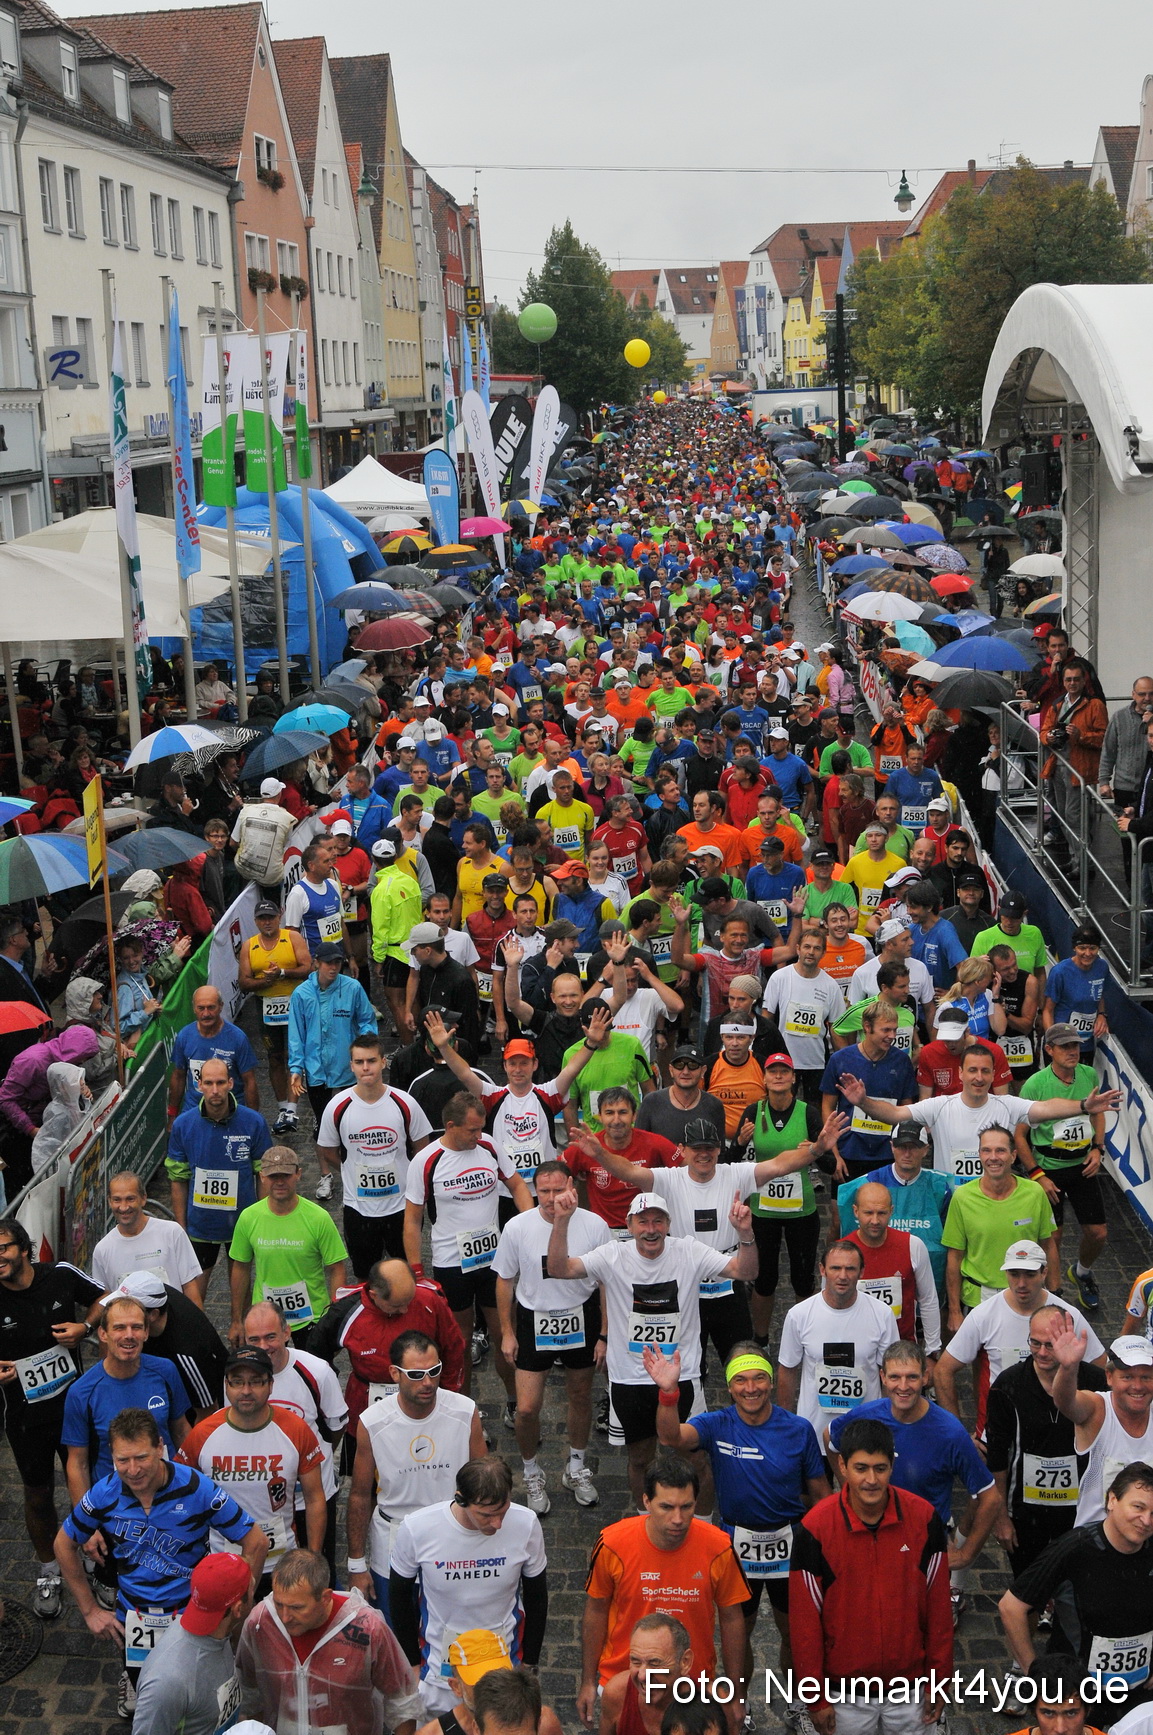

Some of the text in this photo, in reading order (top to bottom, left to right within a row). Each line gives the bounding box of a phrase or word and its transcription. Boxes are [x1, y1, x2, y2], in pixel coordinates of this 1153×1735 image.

[881, 760, 901, 770] 3229
[904, 811, 925, 821] 2593
[556, 832, 578, 844] 2606
[616, 859, 637, 873] 2128
[793, 1011, 816, 1026] 298
[861, 1122, 883, 1130] Andreas
[348, 1131, 388, 1140] GERHART
[1062, 1126, 1085, 1141] 341
[366, 1137, 393, 1145] JANIG
[360, 1172, 395, 1188] 3166
[443, 1172, 486, 1187] GERHART
[464, 1178, 493, 1190] JANIG
[201, 1180, 229, 1195] 189
[364, 1189, 393, 1197] Alexander
[768, 1184, 794, 1198] 807
[201, 1196, 227, 1205] Karlheinz
[888, 1219, 930, 1229] UNNERS
[463, 1233, 498, 1257] 3090
[475, 1255, 492, 1264] Georg
[539, 1316, 580, 1335] 2320
[633, 1325, 677, 1343] 2257
[553, 1337, 568, 1345] Fred
[25, 1356, 70, 1387] 3170
[818, 1377, 863, 1397] 2258
[831, 1398, 849, 1407] Hans
[212, 1454, 284, 1472] MERZ
[211, 1465, 269, 1482] Reisen
[1035, 1469, 1072, 1488] 273
[1039, 1490, 1067, 1499] Markus
[114, 1515, 186, 1557] TEAM
[740, 1540, 789, 1561] 2159
[446, 1557, 507, 1569] INTERSPORT
[748, 1563, 780, 1572] Hartmut
[445, 1569, 500, 1580] TAHEDL
[640, 1572, 660, 1580] DAK
[642, 1586, 700, 1596] SportScheck
[1096, 1647, 1148, 1672] 3358
